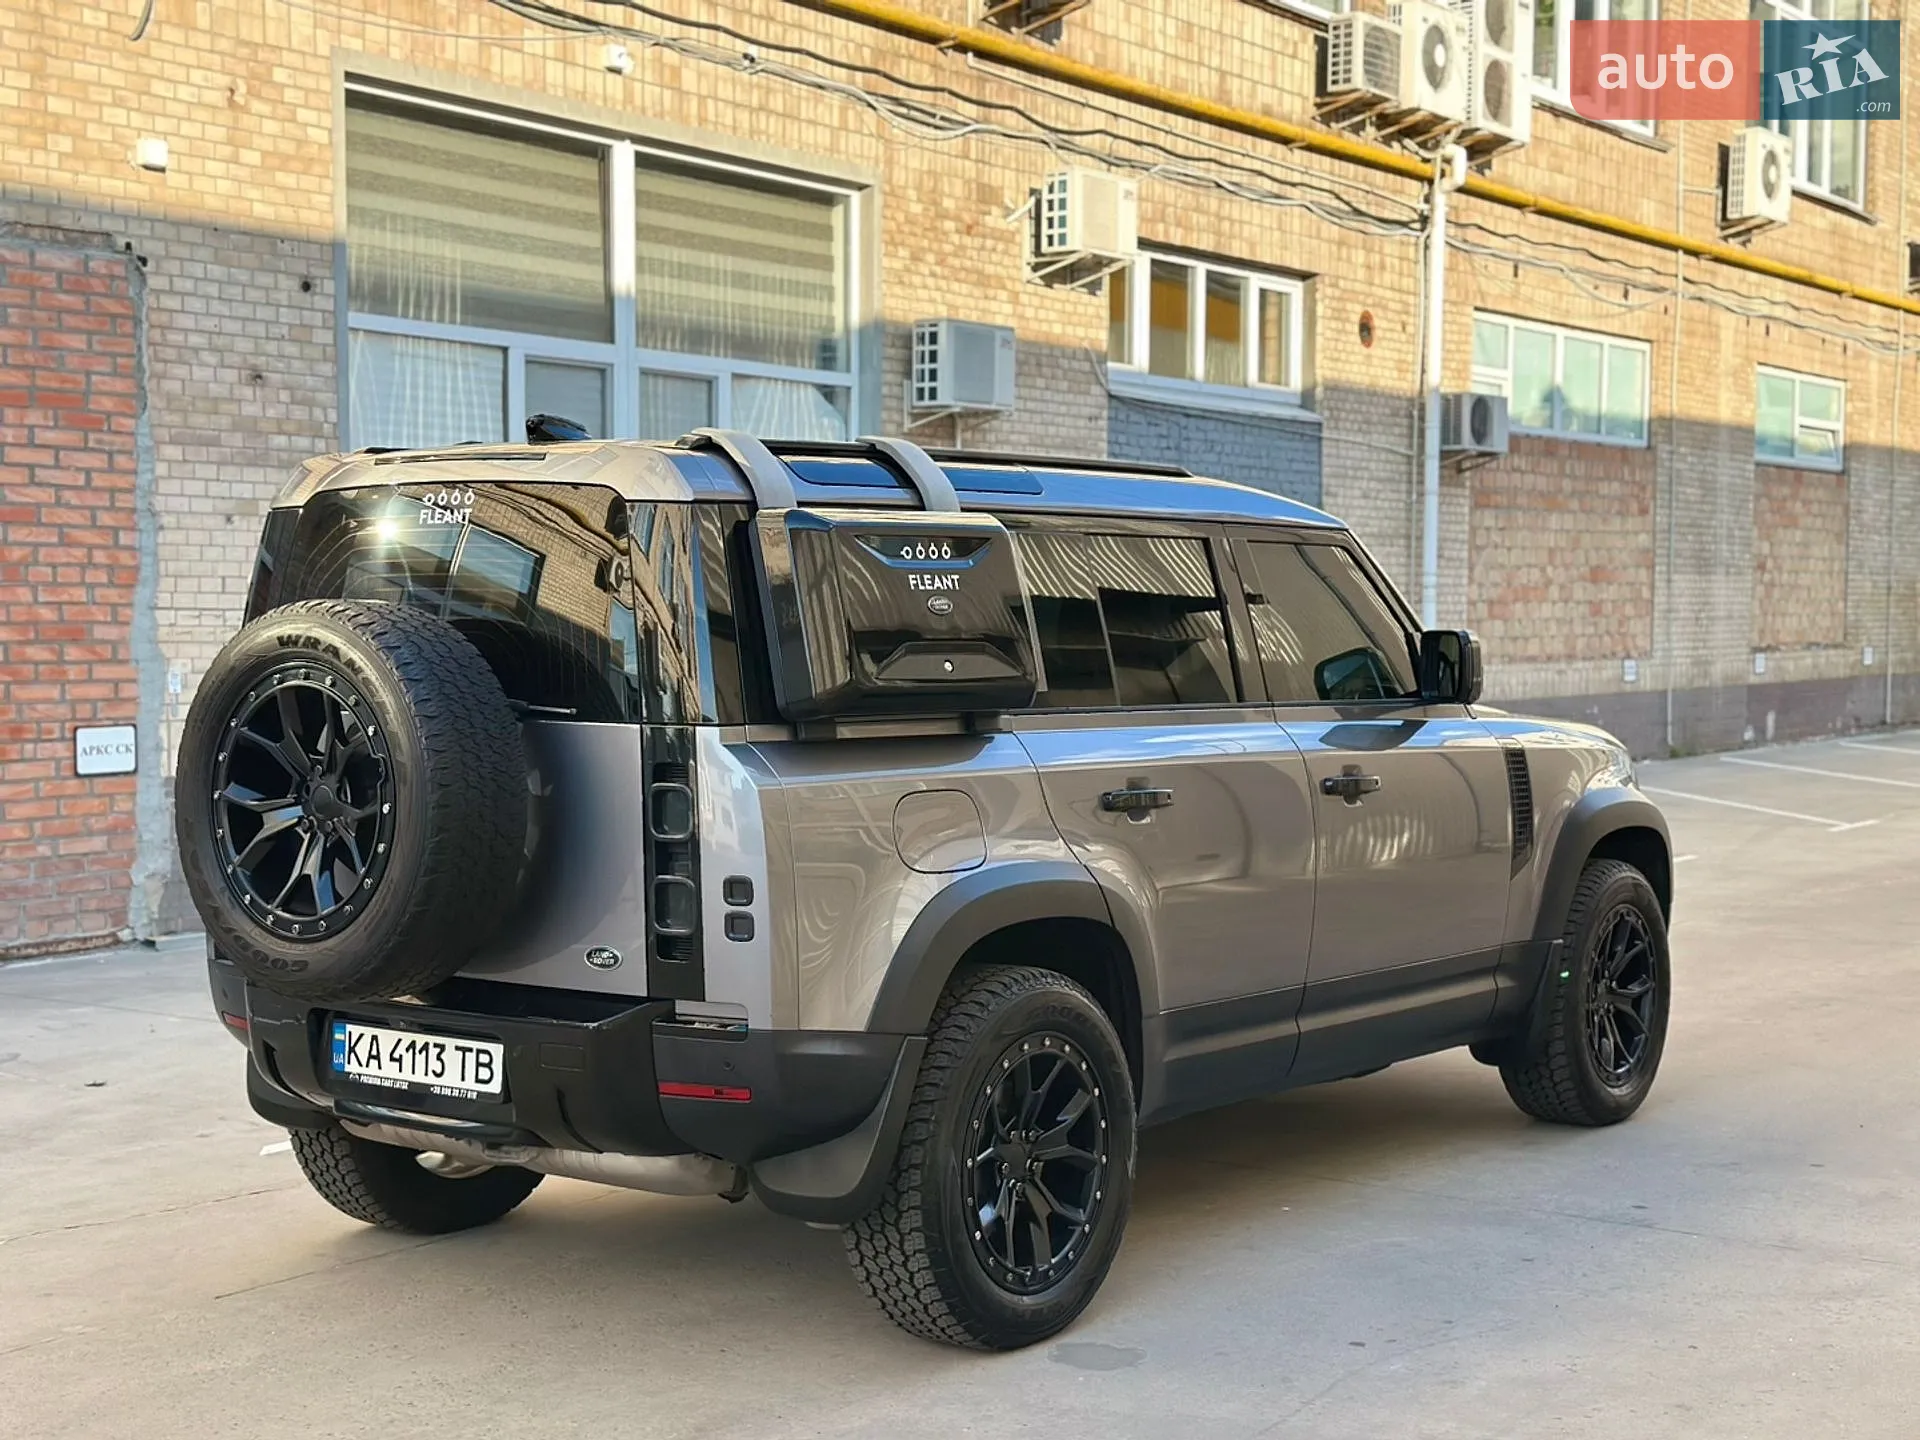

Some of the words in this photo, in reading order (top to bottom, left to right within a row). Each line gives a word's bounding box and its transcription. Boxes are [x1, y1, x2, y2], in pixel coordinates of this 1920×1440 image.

[419, 507, 473, 524] FLEANT
[908, 574, 960, 590] FLEANT
[80, 744, 113, 757] АРКС
[116, 743, 134, 755] СК
[333, 1052, 344, 1065] UA
[347, 1030, 382, 1071] KA
[389, 1037, 446, 1079] 4113
[455, 1045, 495, 1086] TB
